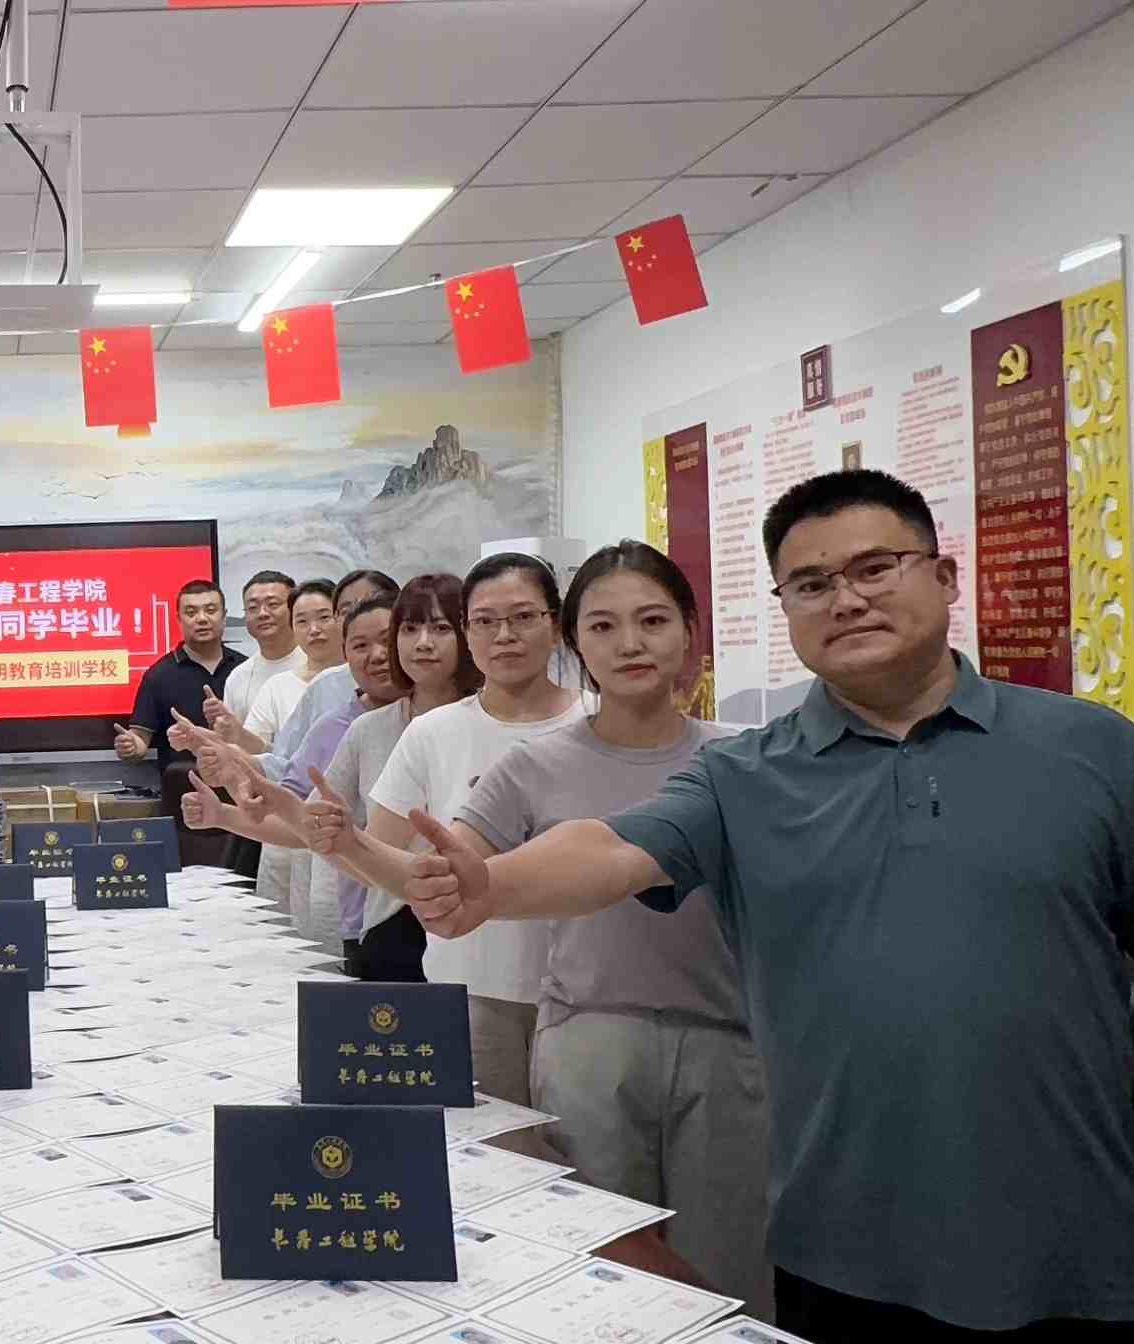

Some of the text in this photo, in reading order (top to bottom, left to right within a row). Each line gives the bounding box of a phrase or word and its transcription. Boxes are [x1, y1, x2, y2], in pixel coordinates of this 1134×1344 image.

[338, 1043, 434, 1057] 毕业证书
[271, 1191, 402, 1211] 毕业证书
